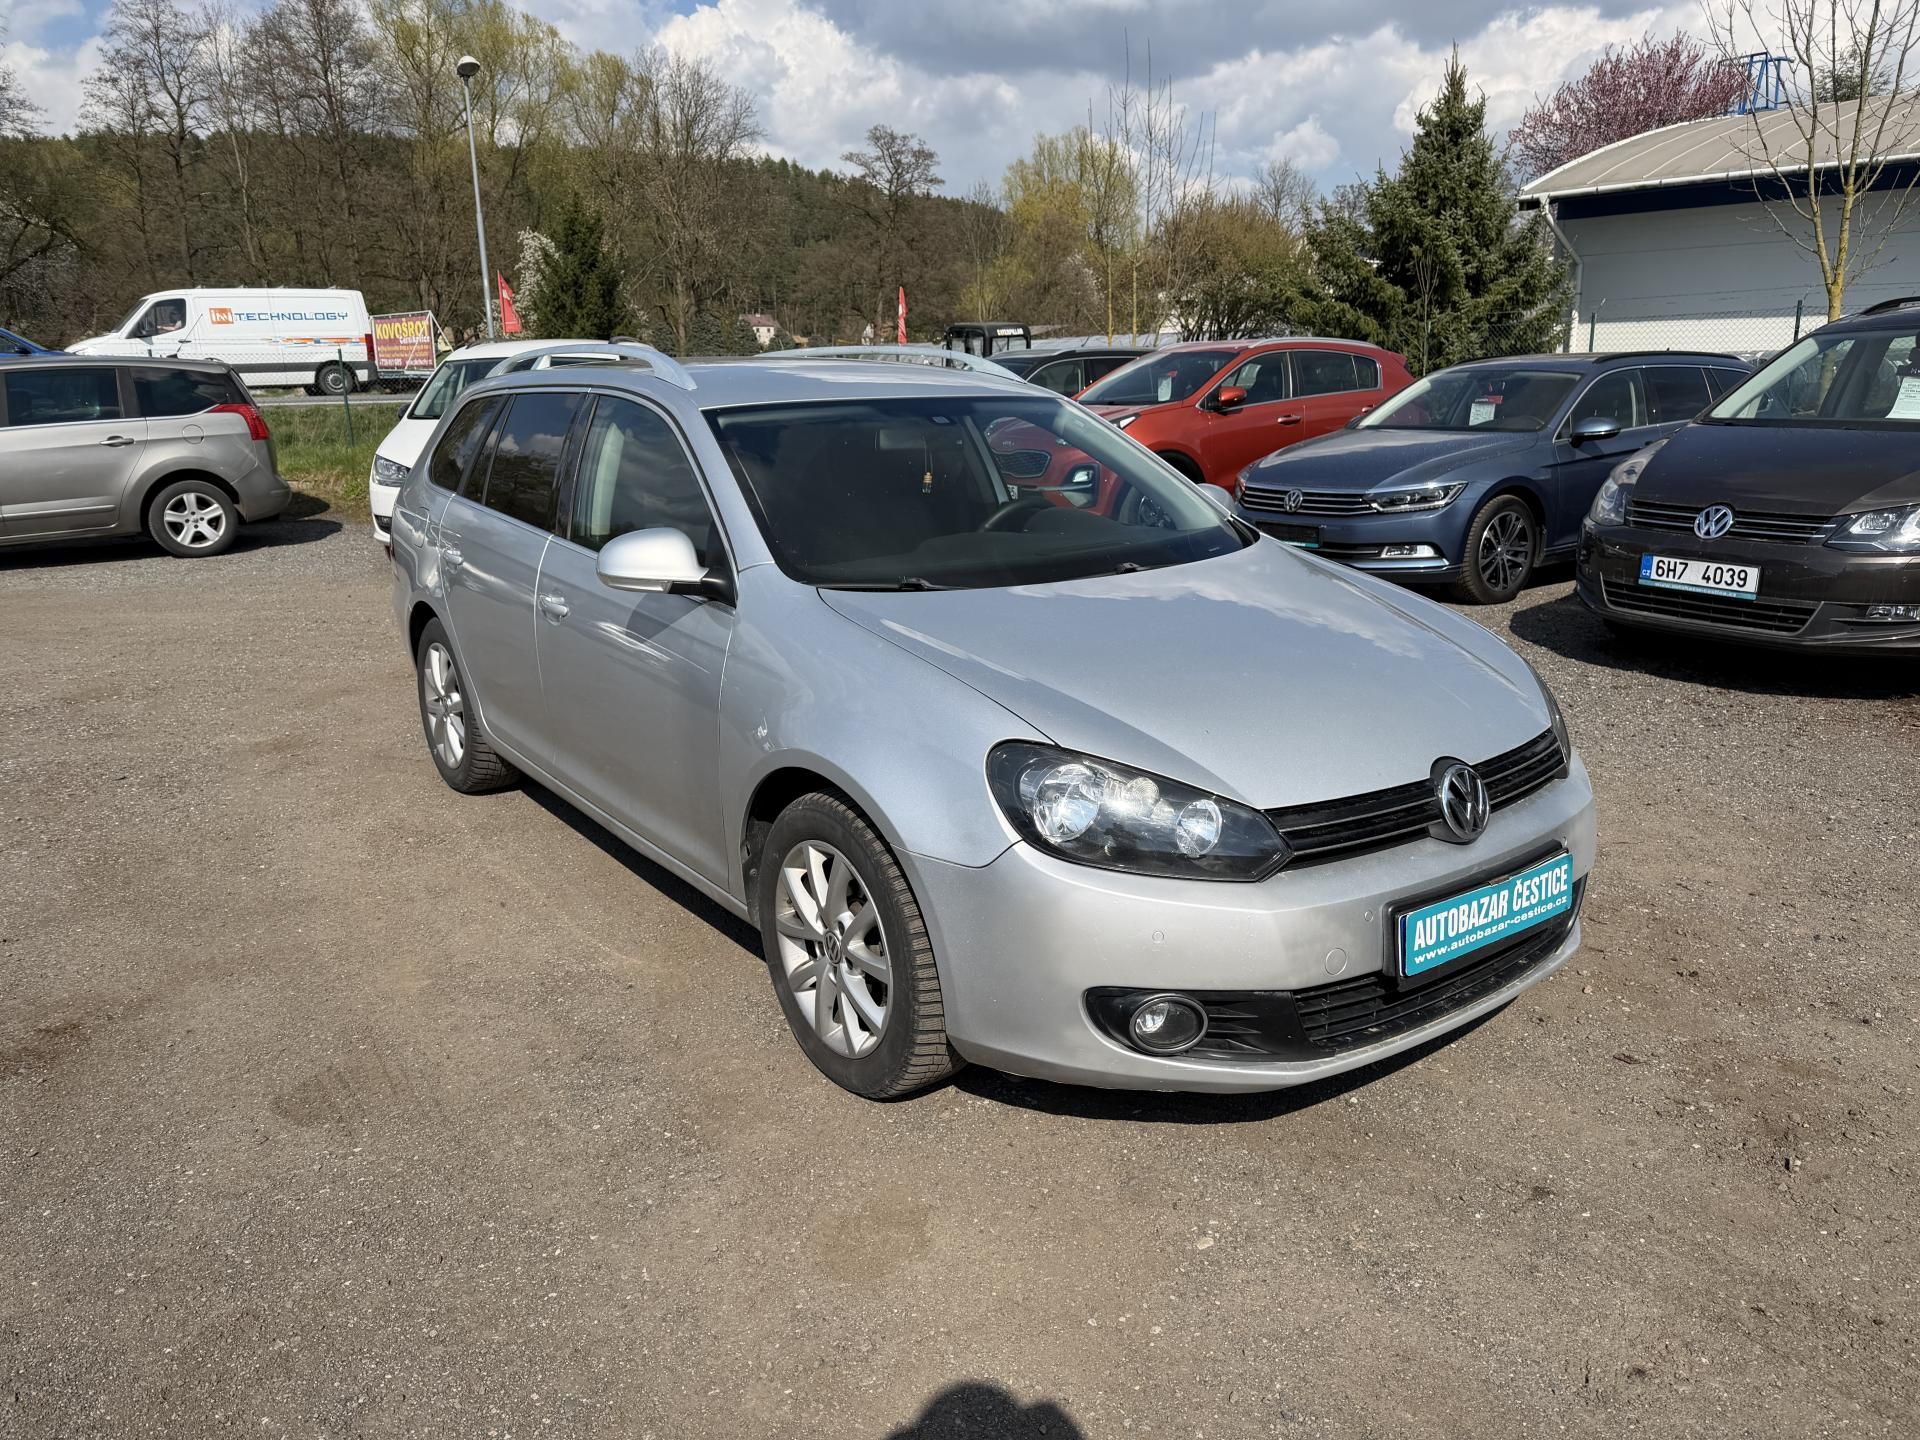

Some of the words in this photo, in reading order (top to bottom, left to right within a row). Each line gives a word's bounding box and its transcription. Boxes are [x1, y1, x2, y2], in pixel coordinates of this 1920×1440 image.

[234, 312, 348, 321] TECHNOLOGY
[376, 317, 429, 340] KOVOŠROT
[1655, 560, 1689, 580] 6H7
[1701, 565, 1749, 588] 4039
[1413, 889, 1509, 951] AUTOBAZAR
[1512, 863, 1568, 912] ČESTICE
[1414, 895, 1568, 964] www.autobazar-cestice.cz
